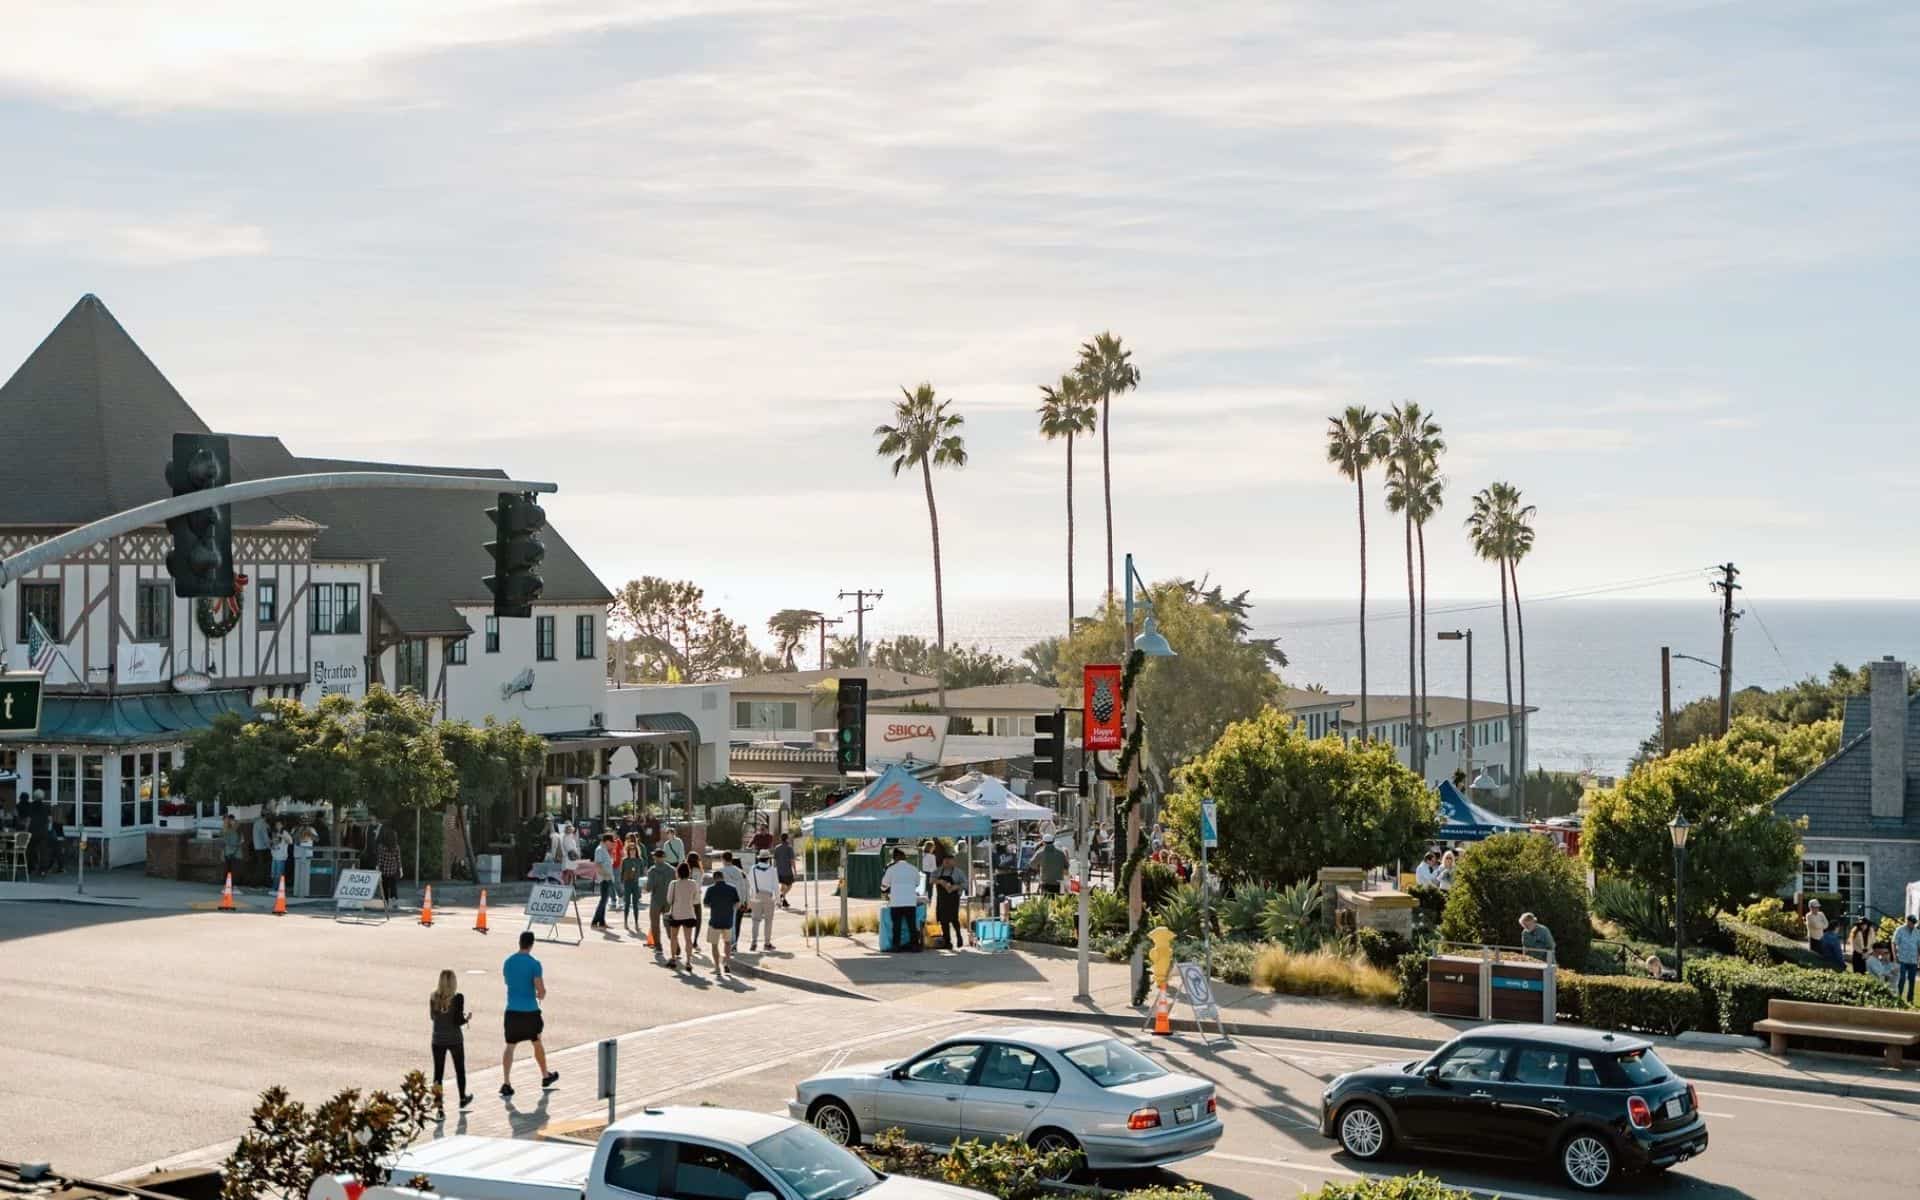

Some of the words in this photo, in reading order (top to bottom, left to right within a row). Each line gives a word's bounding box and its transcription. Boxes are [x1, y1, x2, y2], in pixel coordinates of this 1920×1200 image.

[887, 723, 935, 738] SBICCA
[350, 873, 371, 884] ROAD
[340, 885, 371, 897] CLOSED
[539, 889, 563, 900] ROAD
[530, 901, 564, 913] CLOSED
